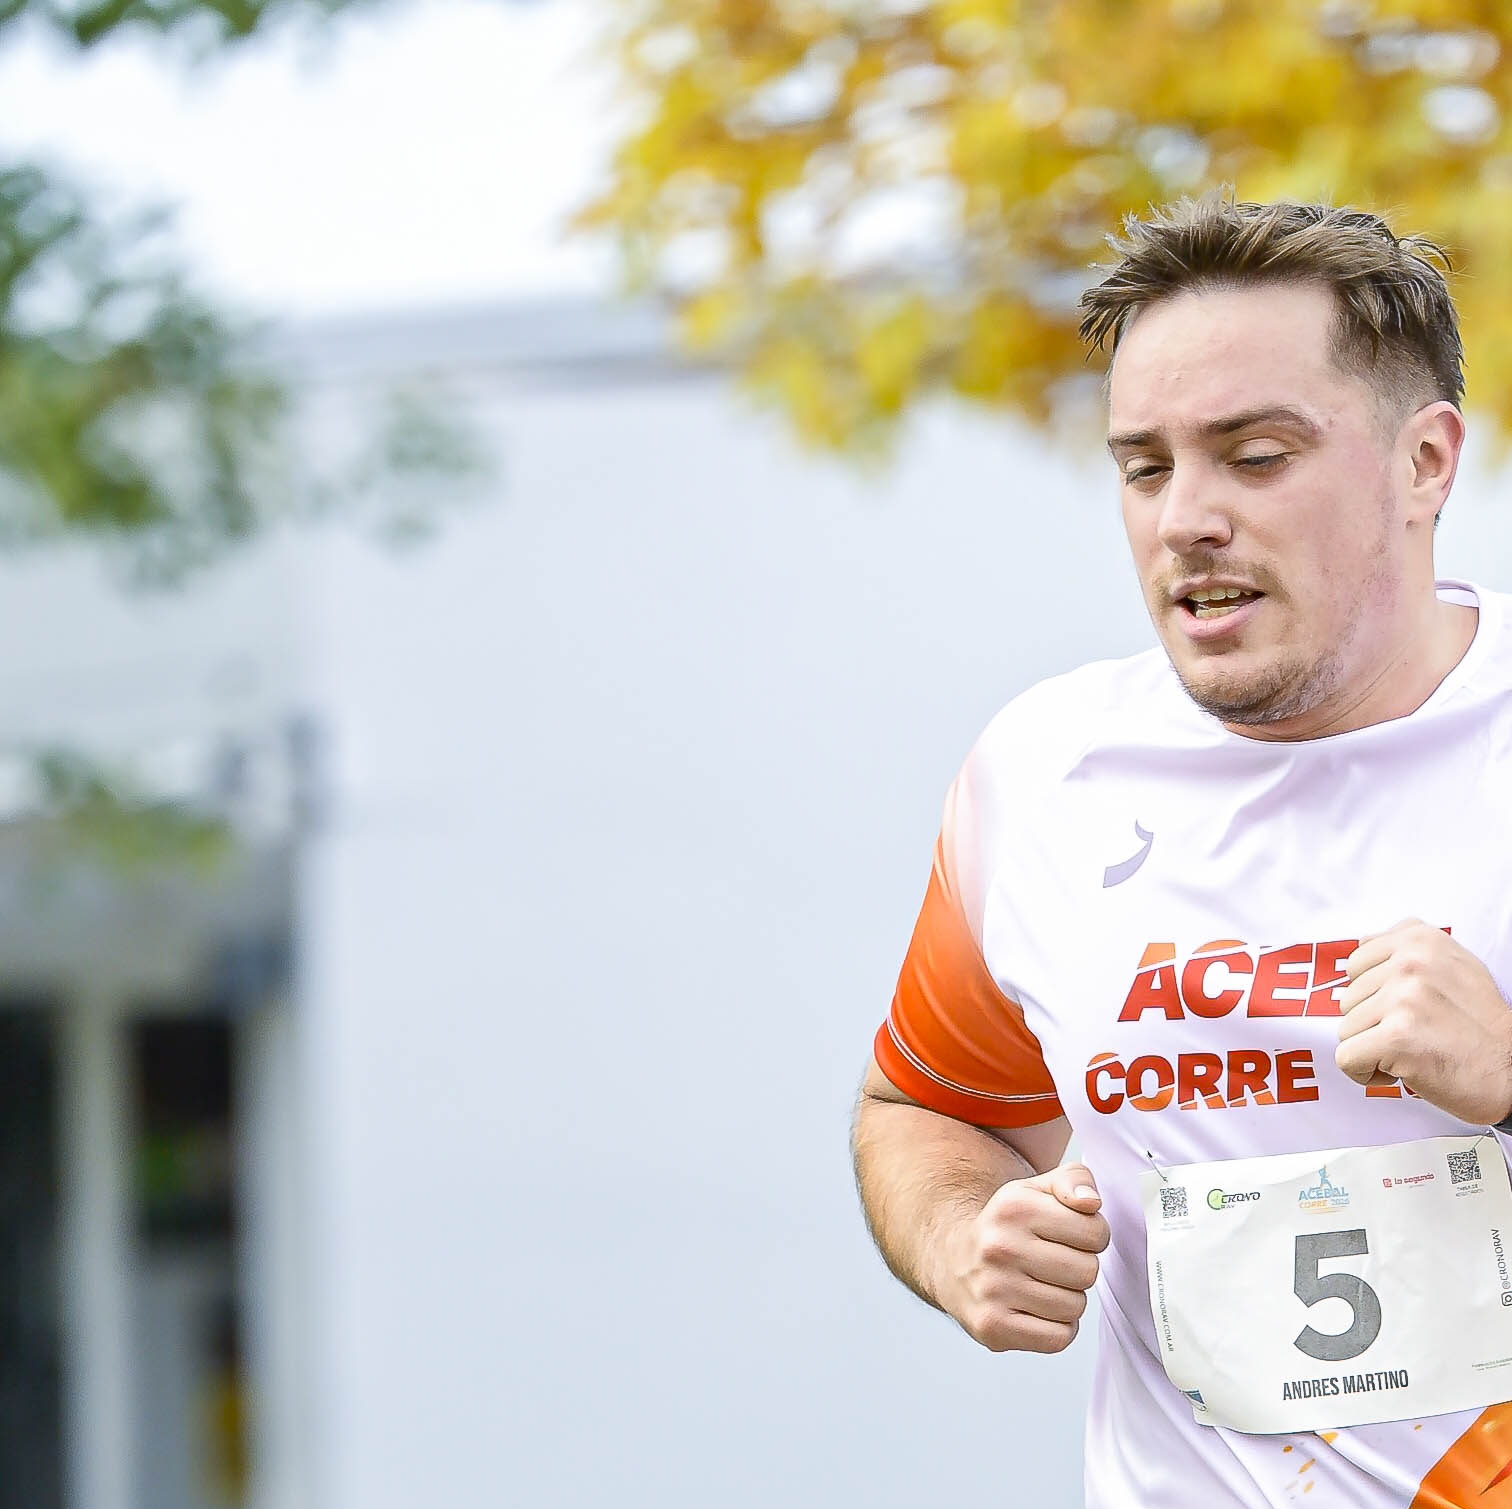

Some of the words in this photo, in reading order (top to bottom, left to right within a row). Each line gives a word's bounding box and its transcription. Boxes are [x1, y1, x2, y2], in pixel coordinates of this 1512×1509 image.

[1085, 1049, 1320, 1115] CORRE
[1298, 1186, 1350, 1201] ACEBAL
[1490, 1228, 1512, 1291] @CRONORAV
[1293, 1228, 1383, 1362] 5
[1282, 1376, 1341, 1401] ANDRES
[1342, 1369, 1410, 1395] MARTINO
